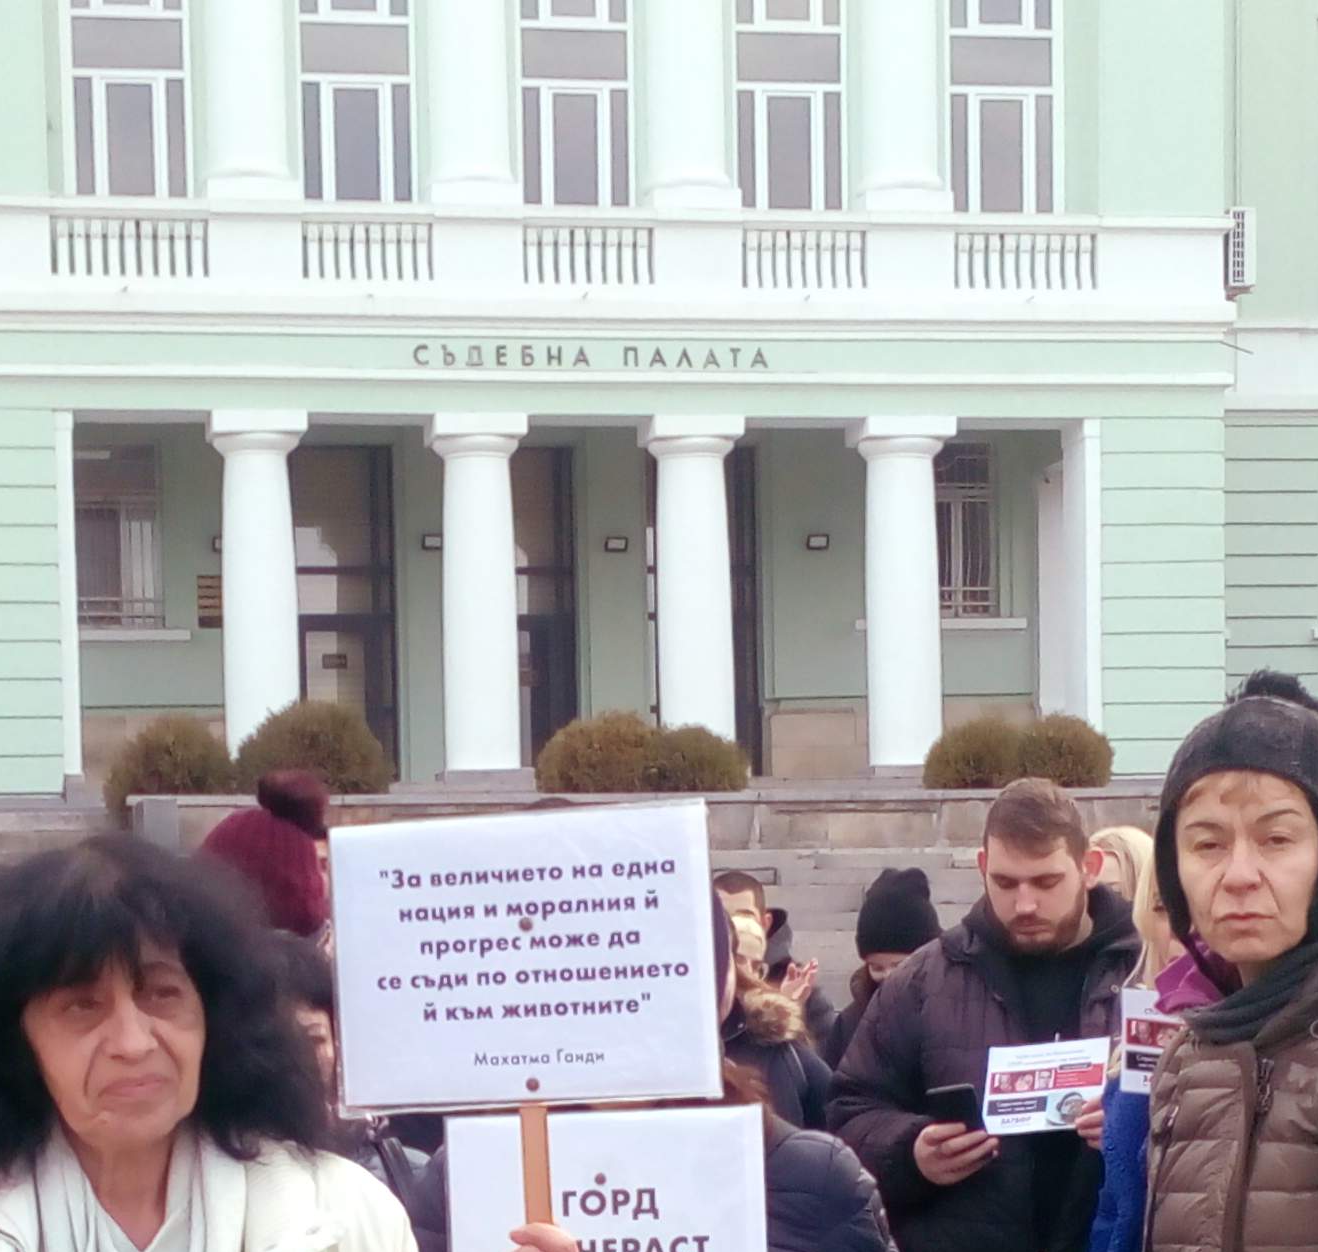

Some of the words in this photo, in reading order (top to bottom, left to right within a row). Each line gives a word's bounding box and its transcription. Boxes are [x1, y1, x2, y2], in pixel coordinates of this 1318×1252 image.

[412, 344, 591, 368] СЪДЕБНА
[623, 346, 769, 369] ПАЛАТА
[379, 869, 421, 889] "За
[430, 866, 563, 887] величието
[572, 861, 603, 879] на
[611, 858, 676, 880] една
[399, 902, 475, 923] нация
[484, 903, 497, 918] и
[506, 895, 636, 921] моралния
[645, 890, 659, 909] й
[420, 936, 522, 960] прогрес
[530, 931, 600, 950] може
[608, 929, 641, 950] да
[377, 974, 402, 990] се
[411, 970, 468, 991] съди
[477, 968, 507, 986] по
[516, 962, 689, 984] отношението
[423, 1002, 437, 1022] й
[445, 1003, 494, 1021] към
[502, 992, 651, 1019] животните"
[474, 1050, 550, 1067] Махатма
[556, 1048, 605, 1066] Ганди
[561, 1188, 660, 1220] ГОРД
